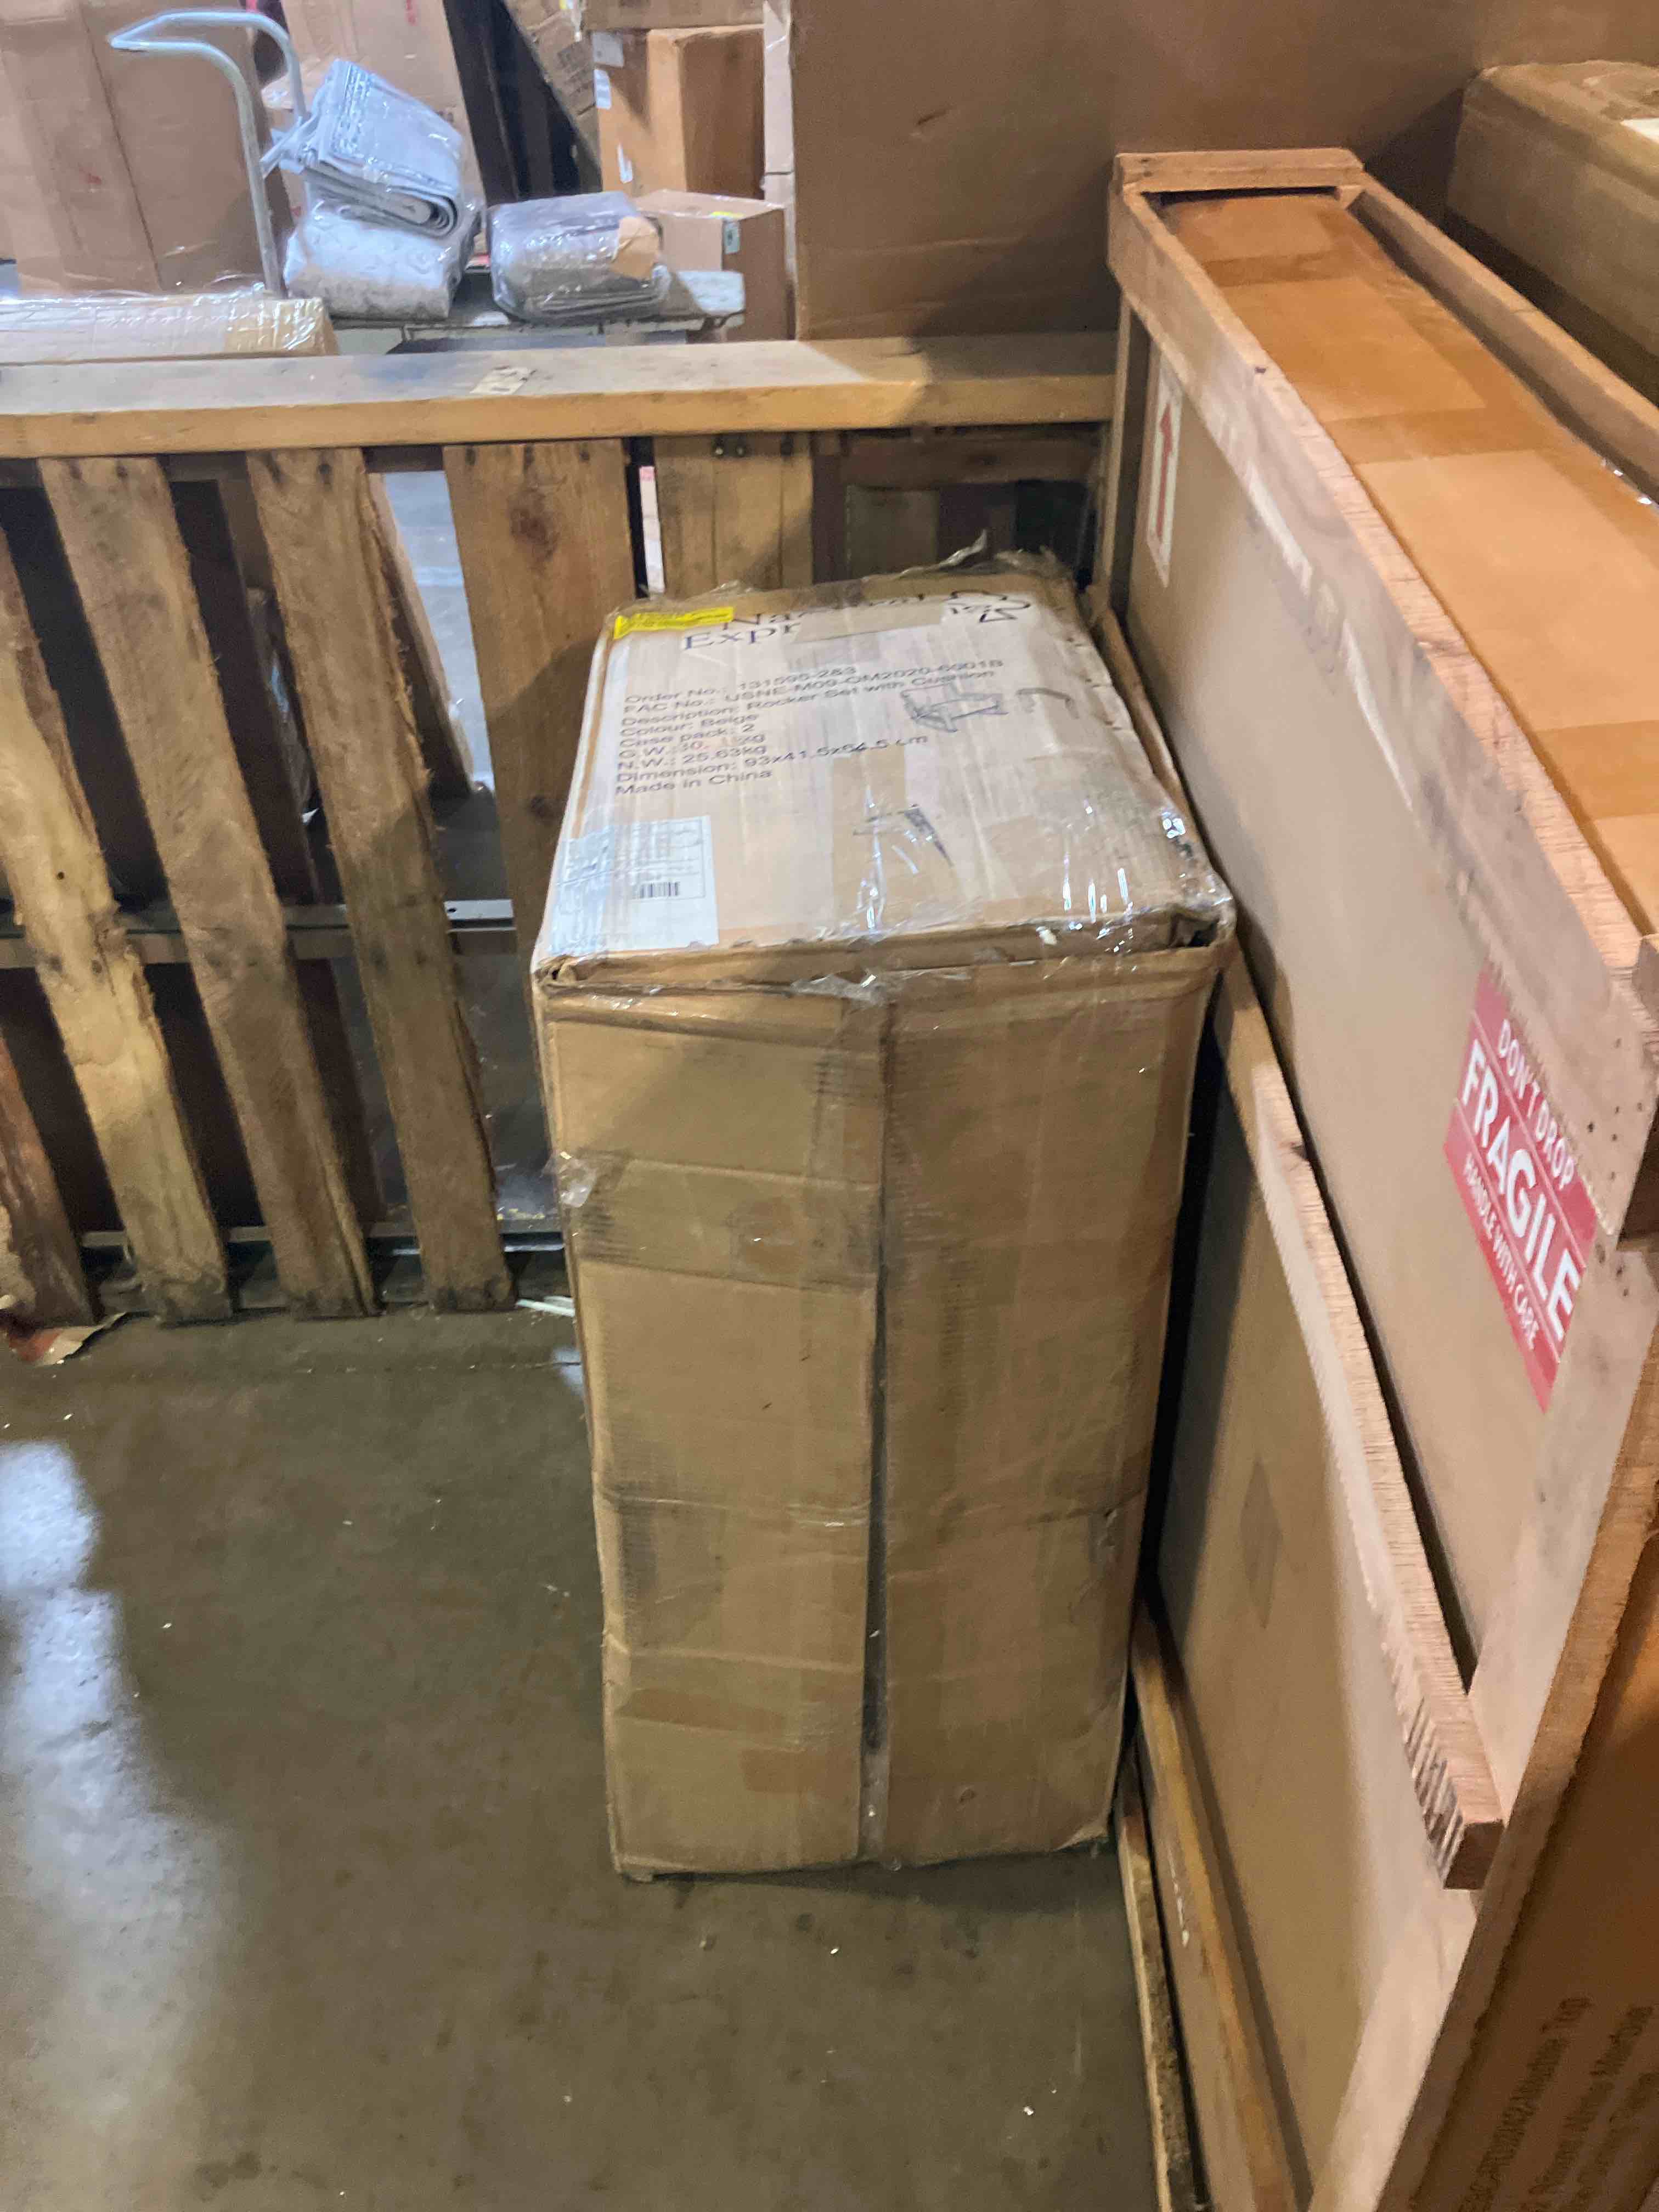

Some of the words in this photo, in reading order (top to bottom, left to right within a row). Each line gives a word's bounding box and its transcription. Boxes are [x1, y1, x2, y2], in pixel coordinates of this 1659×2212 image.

[624, 692, 680, 703] Order
[701, 714, 760, 726] Beige
[619, 736, 674, 747] Case
[742, 723, 755, 733] 2
[615, 782, 675, 794] Made
[682, 779, 702, 788] in
[708, 771, 773, 785] China
[617, 762, 737, 782] Dimension:
[1535, 1099, 1575, 1191] DROP
[1462, 1039, 1580, 1341] FRAGILE
[1464, 1153, 1496, 1239] HANDLE
[1493, 1227, 1516, 1295] WITH
[1514, 1283, 1539, 1351] CARE
